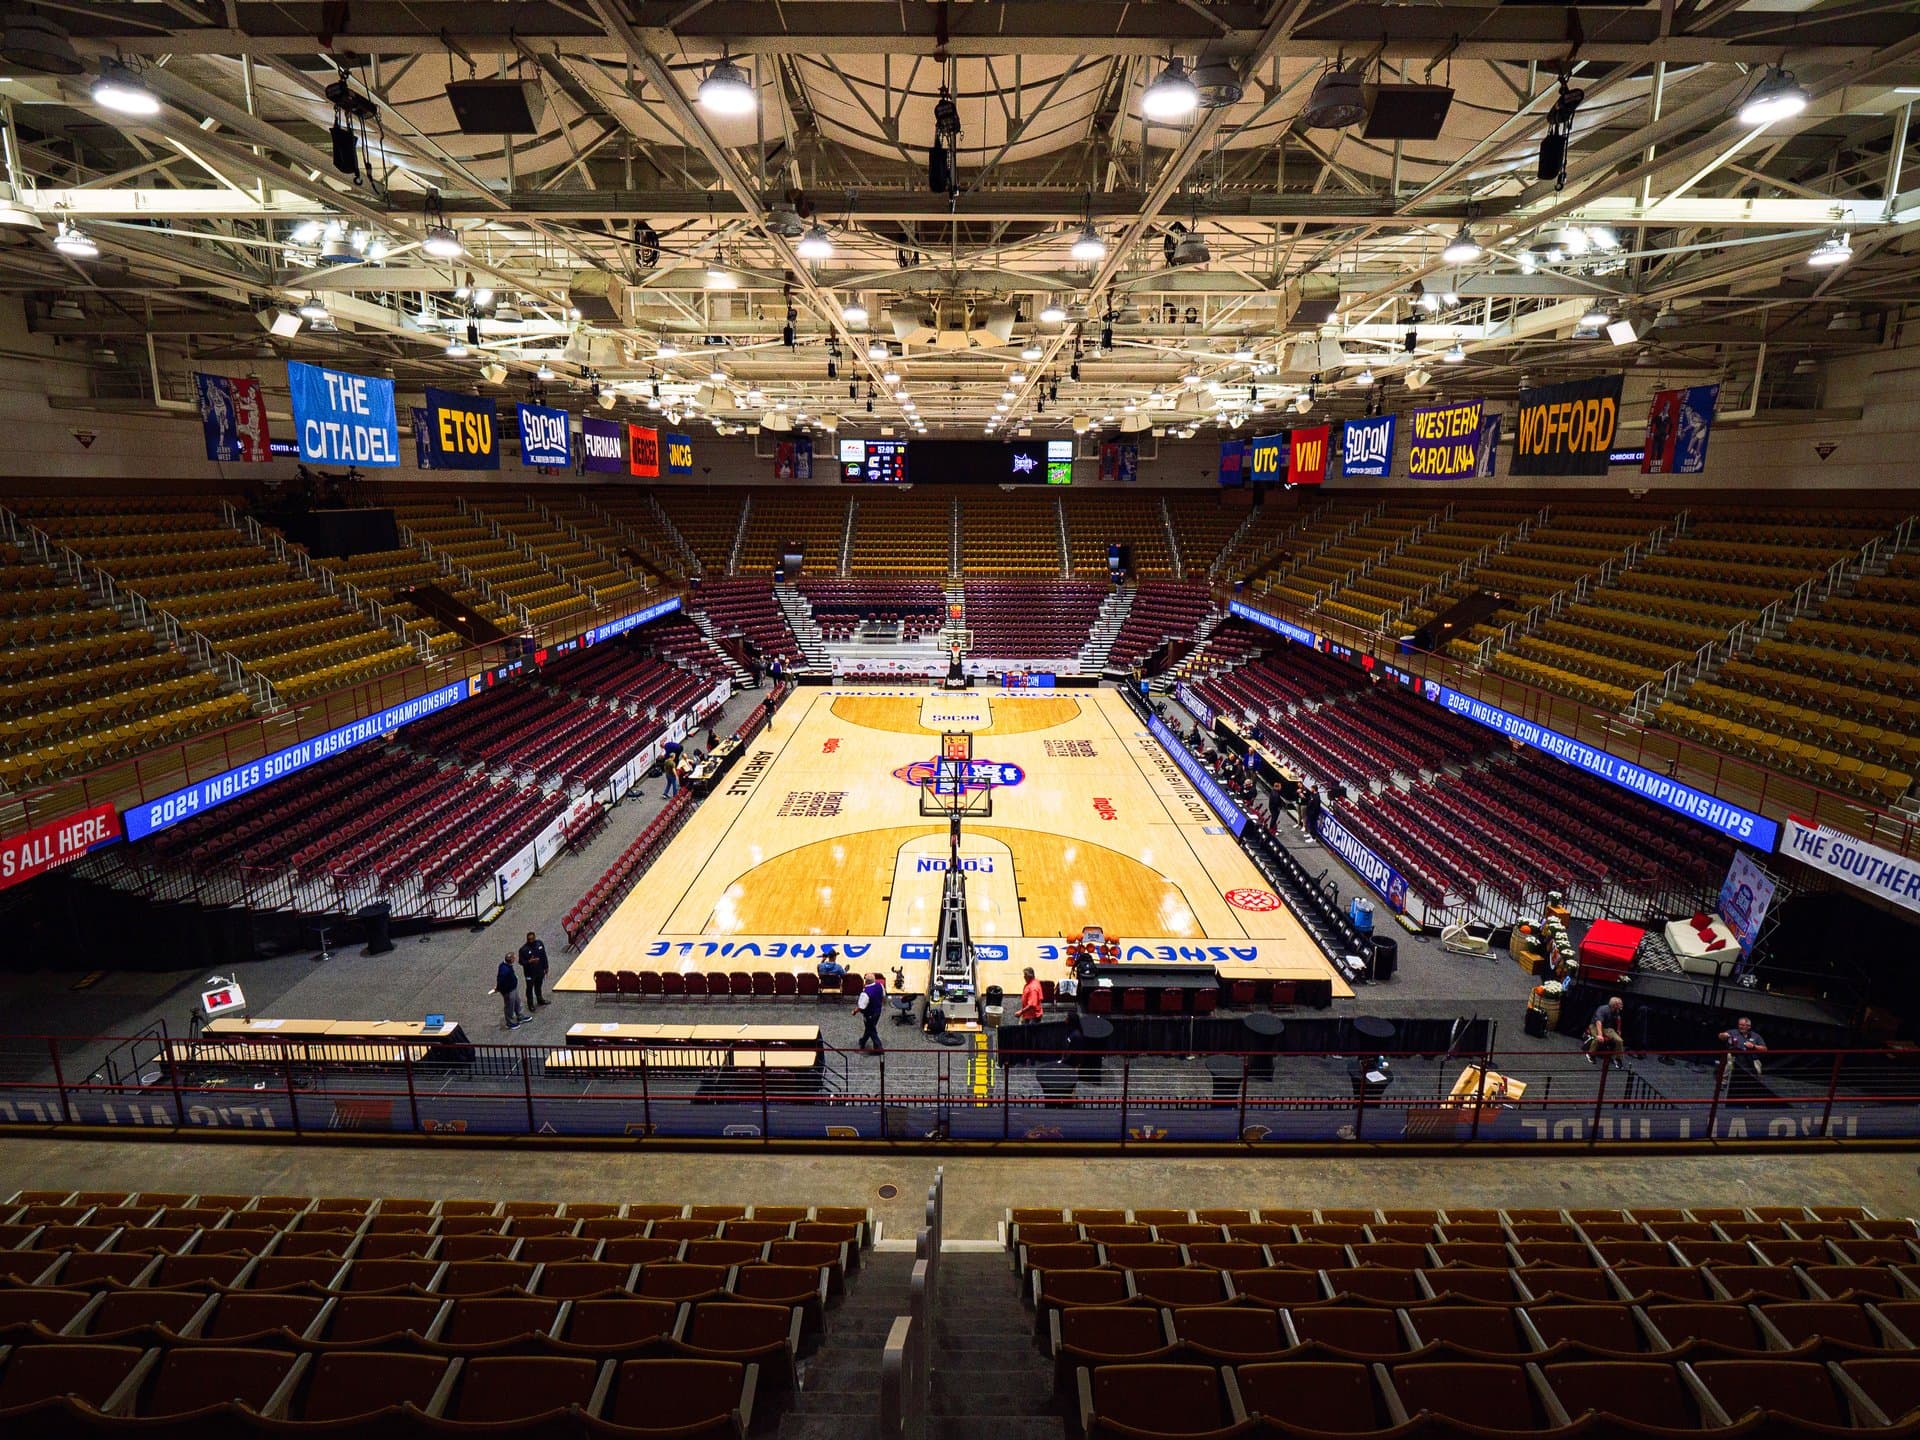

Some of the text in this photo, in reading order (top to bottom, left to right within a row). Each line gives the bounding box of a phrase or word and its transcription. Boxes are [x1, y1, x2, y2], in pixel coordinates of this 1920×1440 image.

[323, 372, 370, 416] THE
[305, 419, 397, 463] CITADEL
[438, 407, 492, 454] ETSU
[522, 409, 567, 453] SOCON
[1345, 421, 1390, 464] SOCON
[1415, 403, 1481, 439] WESTERN
[1519, 397, 1616, 456] WOFFORD
[270, 444, 290, 452] CENTER
[585, 434, 621, 459] FURMAN
[668, 443, 692, 467] UNCG
[1253, 447, 1279, 473] UTC
[1296, 440, 1322, 472] VMI
[1409, 444, 1475, 475] CAROLINA
[150, 686, 459, 828] 2024 INGLES SOCON BASKETBALL CHAMPIONSHIPS
[726, 750, 774, 796] ASHEVILLE
[1448, 693, 1754, 837] 2024 INGLES SOCON BASKETBALL CHAMPIONSHIPS
[1139, 740, 1212, 822] ExploreAsheville.com
[1200, 776, 1239, 825] CHAMPIONSHIPS
[19, 836, 55, 872] ALL
[59, 815, 111, 855] HERE.
[1322, 816, 1391, 893] SOCONHOOPS
[1792, 827, 1828, 859] THE
[645, 941, 872, 958] ASHEVILLE
